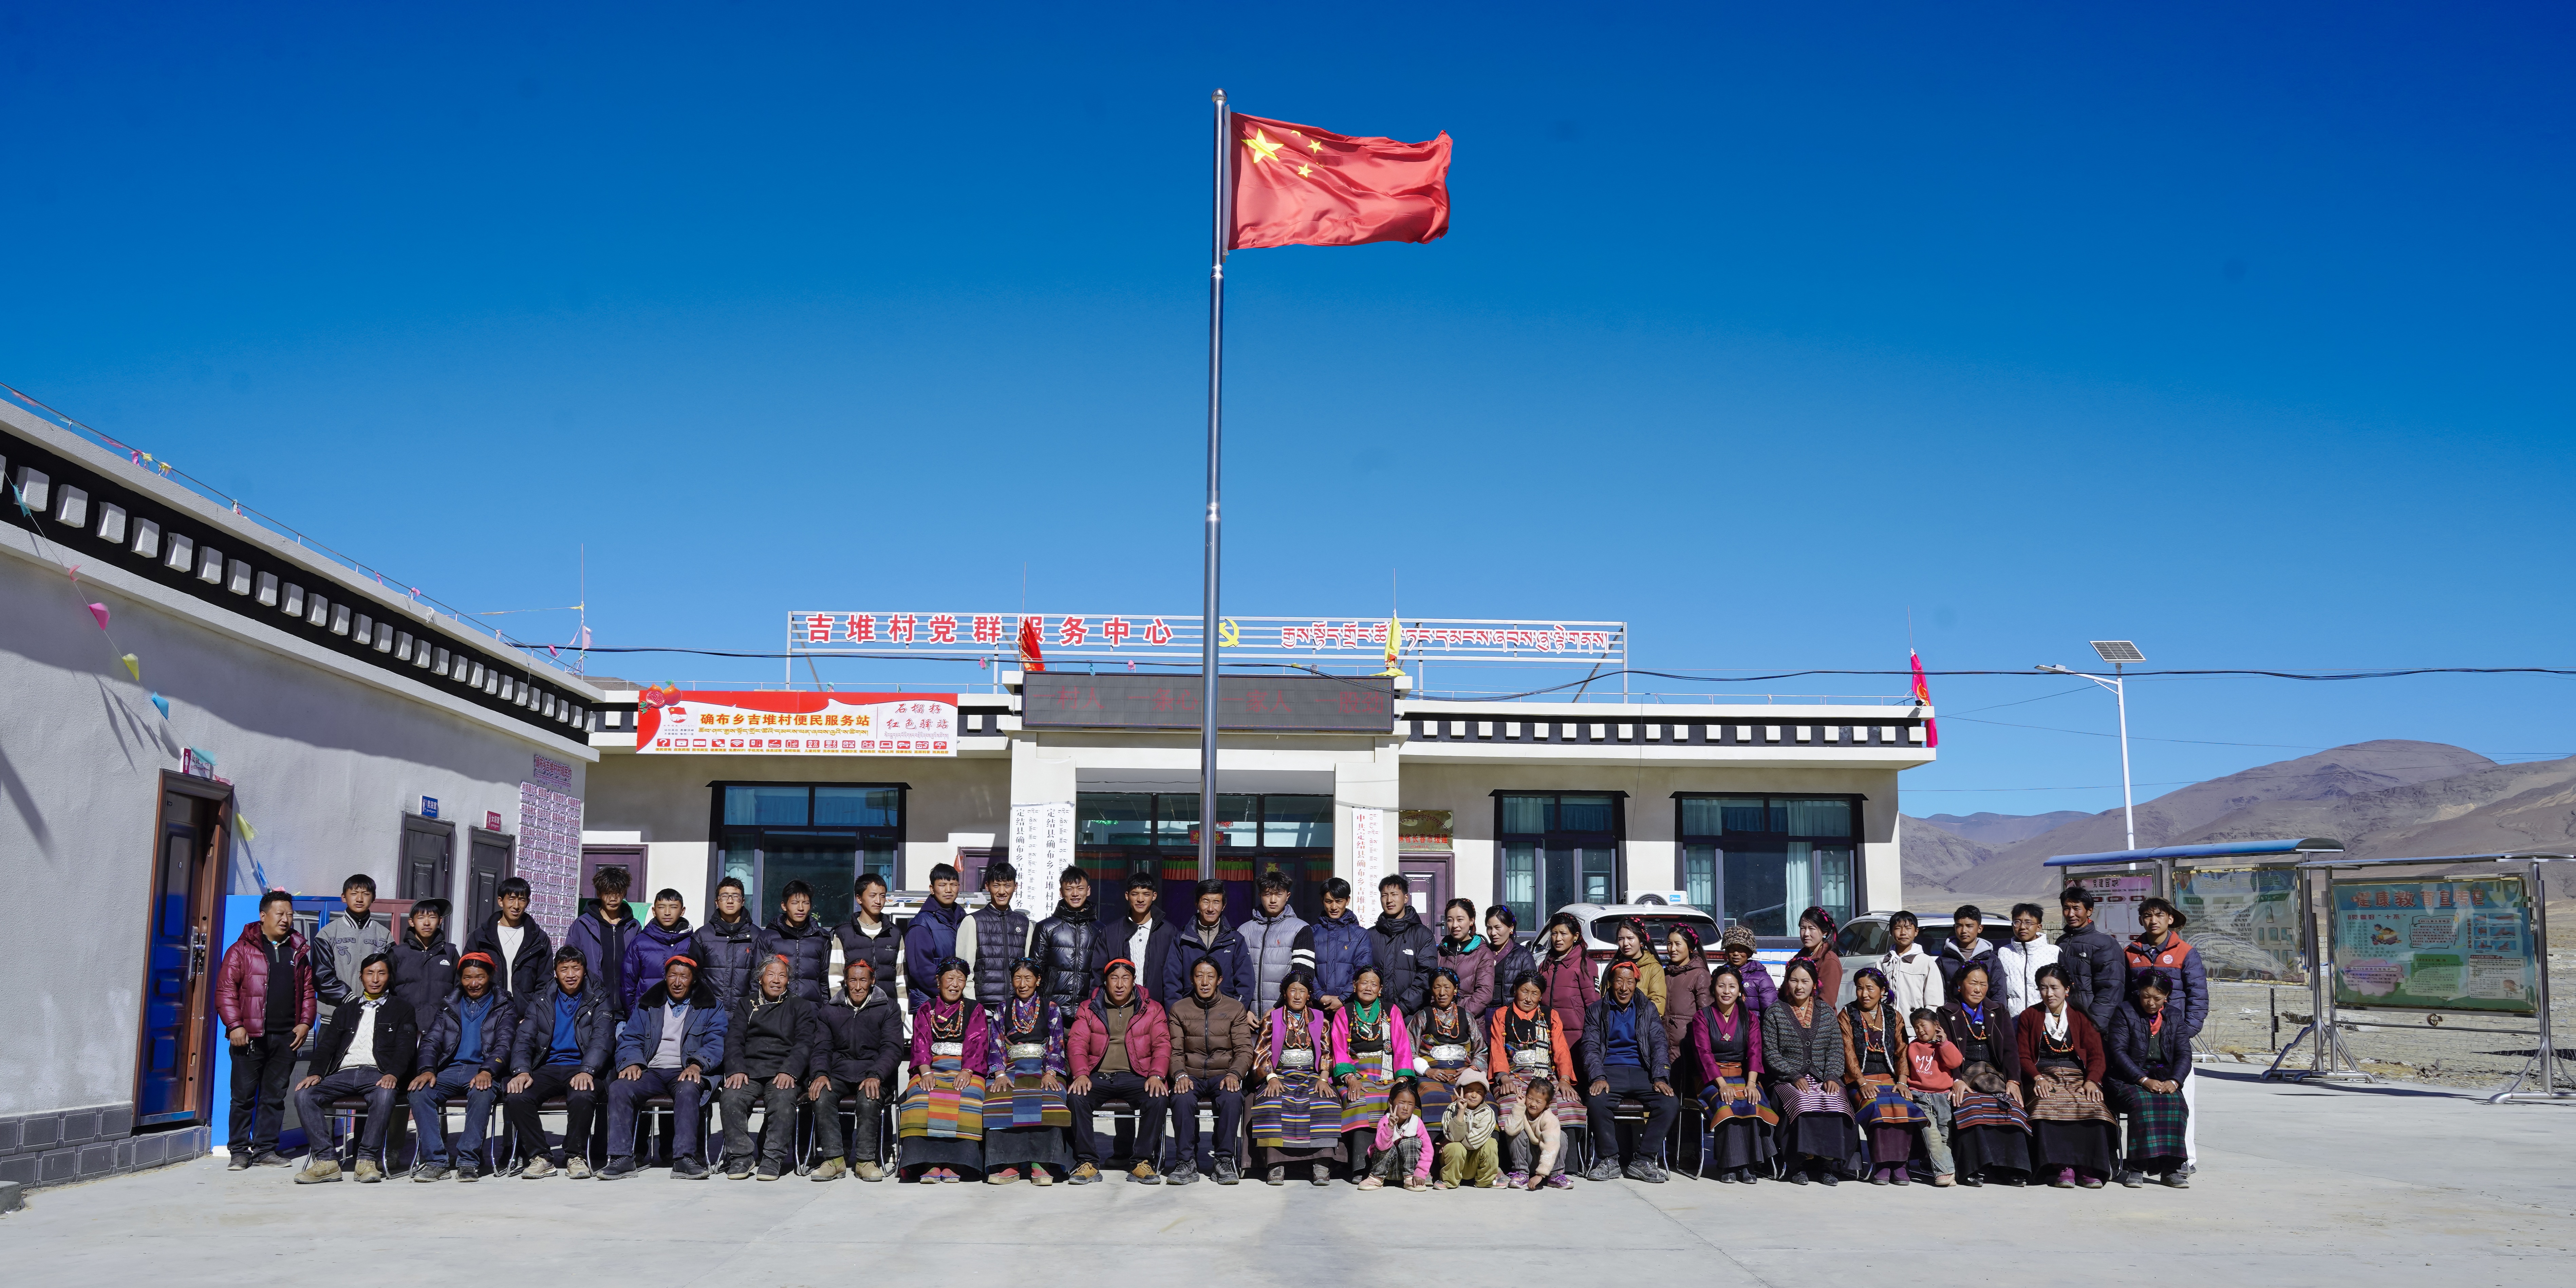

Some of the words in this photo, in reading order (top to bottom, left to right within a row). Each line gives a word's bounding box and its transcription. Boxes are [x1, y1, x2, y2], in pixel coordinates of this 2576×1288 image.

[806, 613, 1173, 647] 吉堆村党群服务中心
[1033, 686, 1105, 710] 一村人
[1128, 689, 1199, 711] 一条心
[1223, 689, 1292, 713] 一家人
[1315, 691, 1384, 714] 一股劲
[895, 703, 942, 714] 石榴籽
[700, 713, 870, 727] 确布乡吉堆村便民服务站
[886, 718, 949, 731] 红色驿站
[2351, 889, 2484, 908] 健康教育宣传栏
